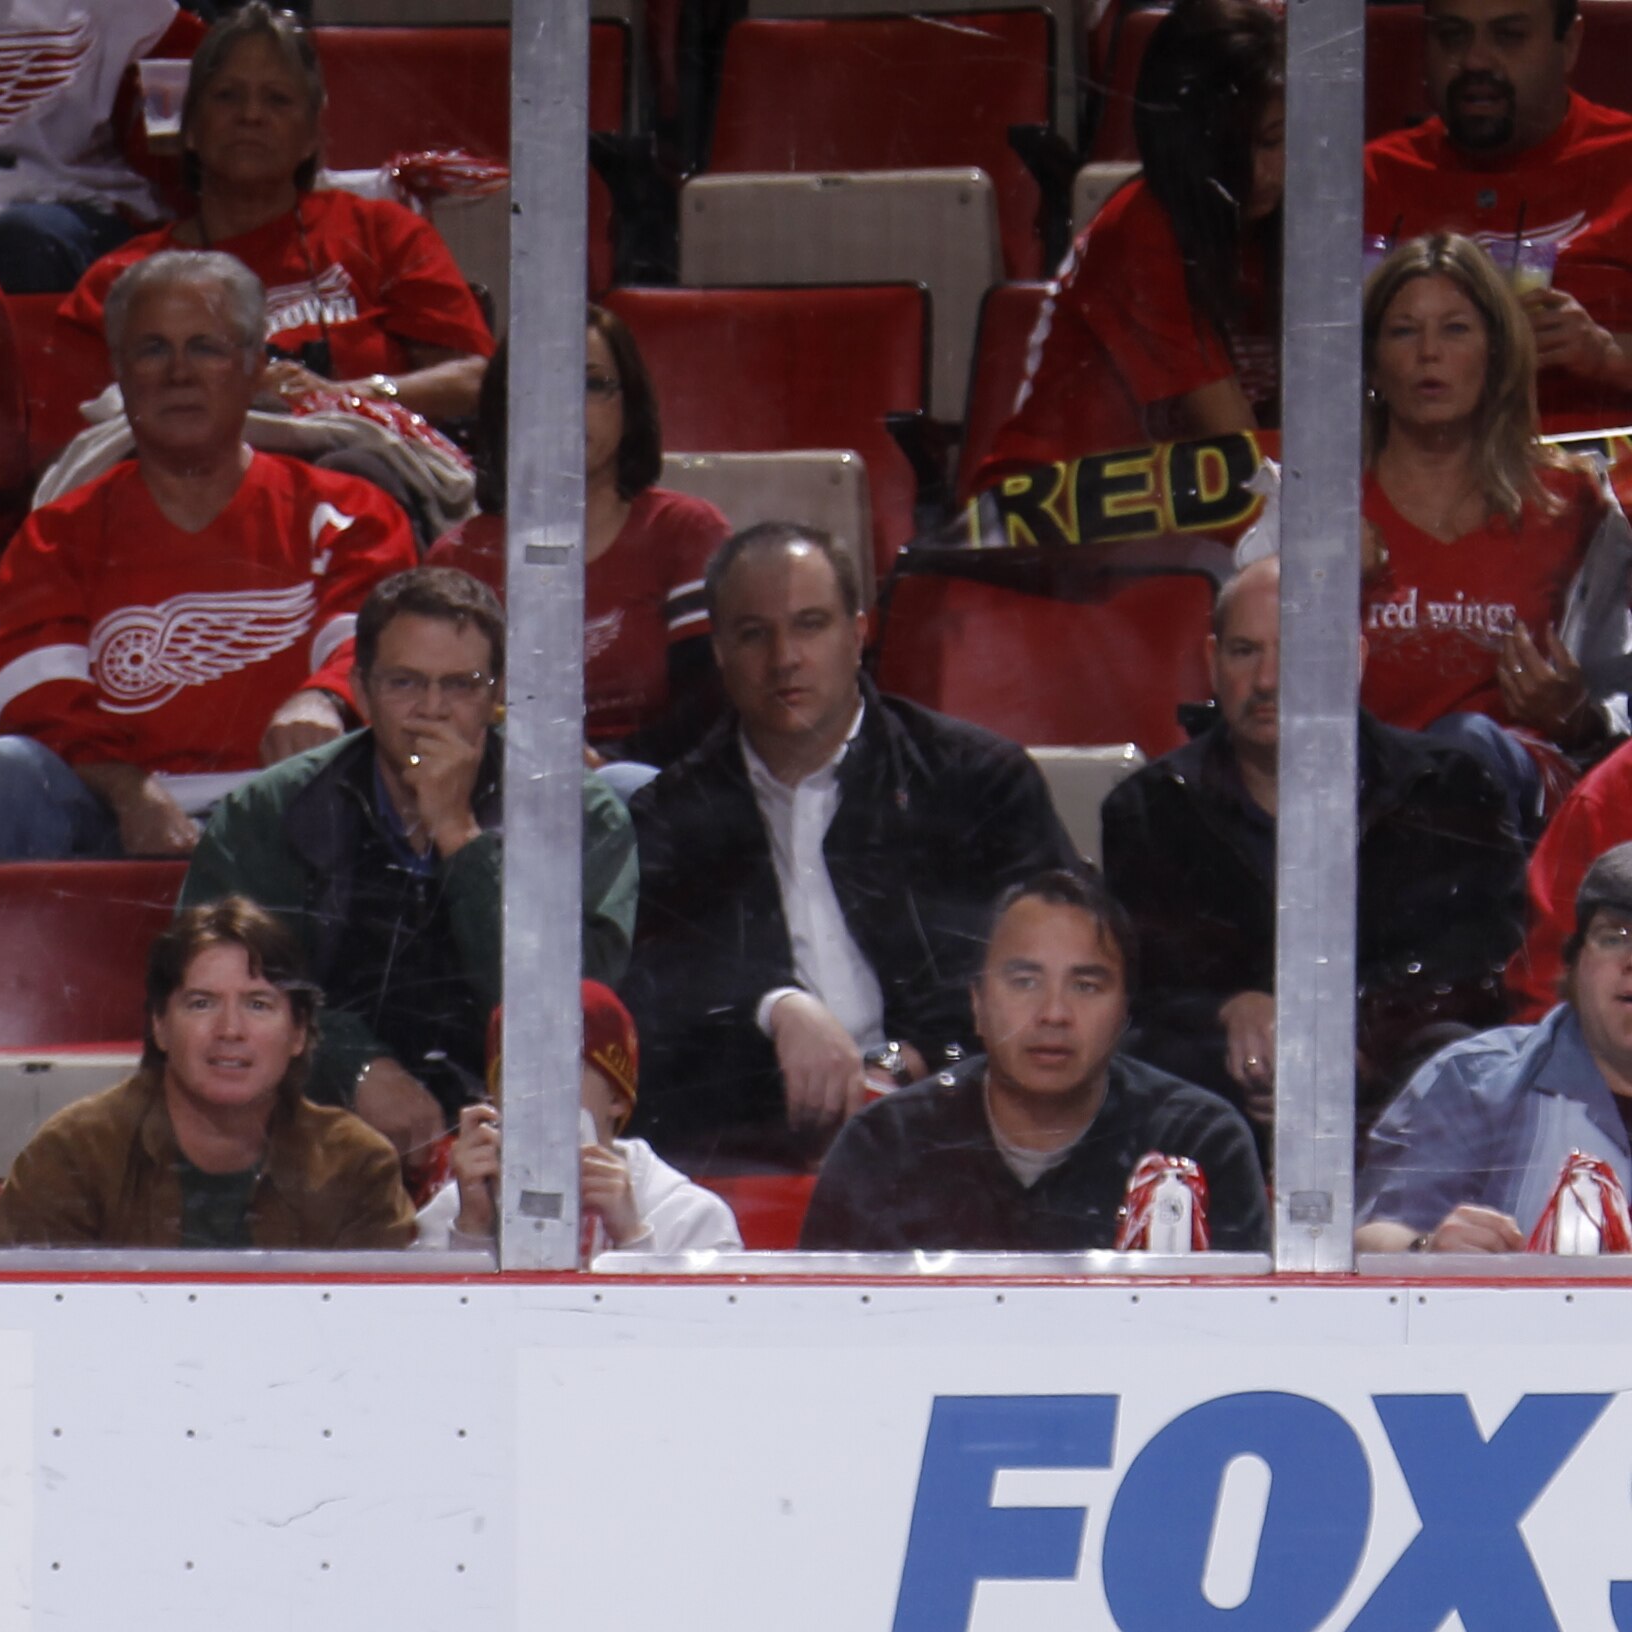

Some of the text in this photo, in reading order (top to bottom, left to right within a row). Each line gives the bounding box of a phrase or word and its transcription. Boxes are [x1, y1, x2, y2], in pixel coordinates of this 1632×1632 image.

[969, 432, 1259, 548] RED
[1367, 587, 1517, 637] red wings
